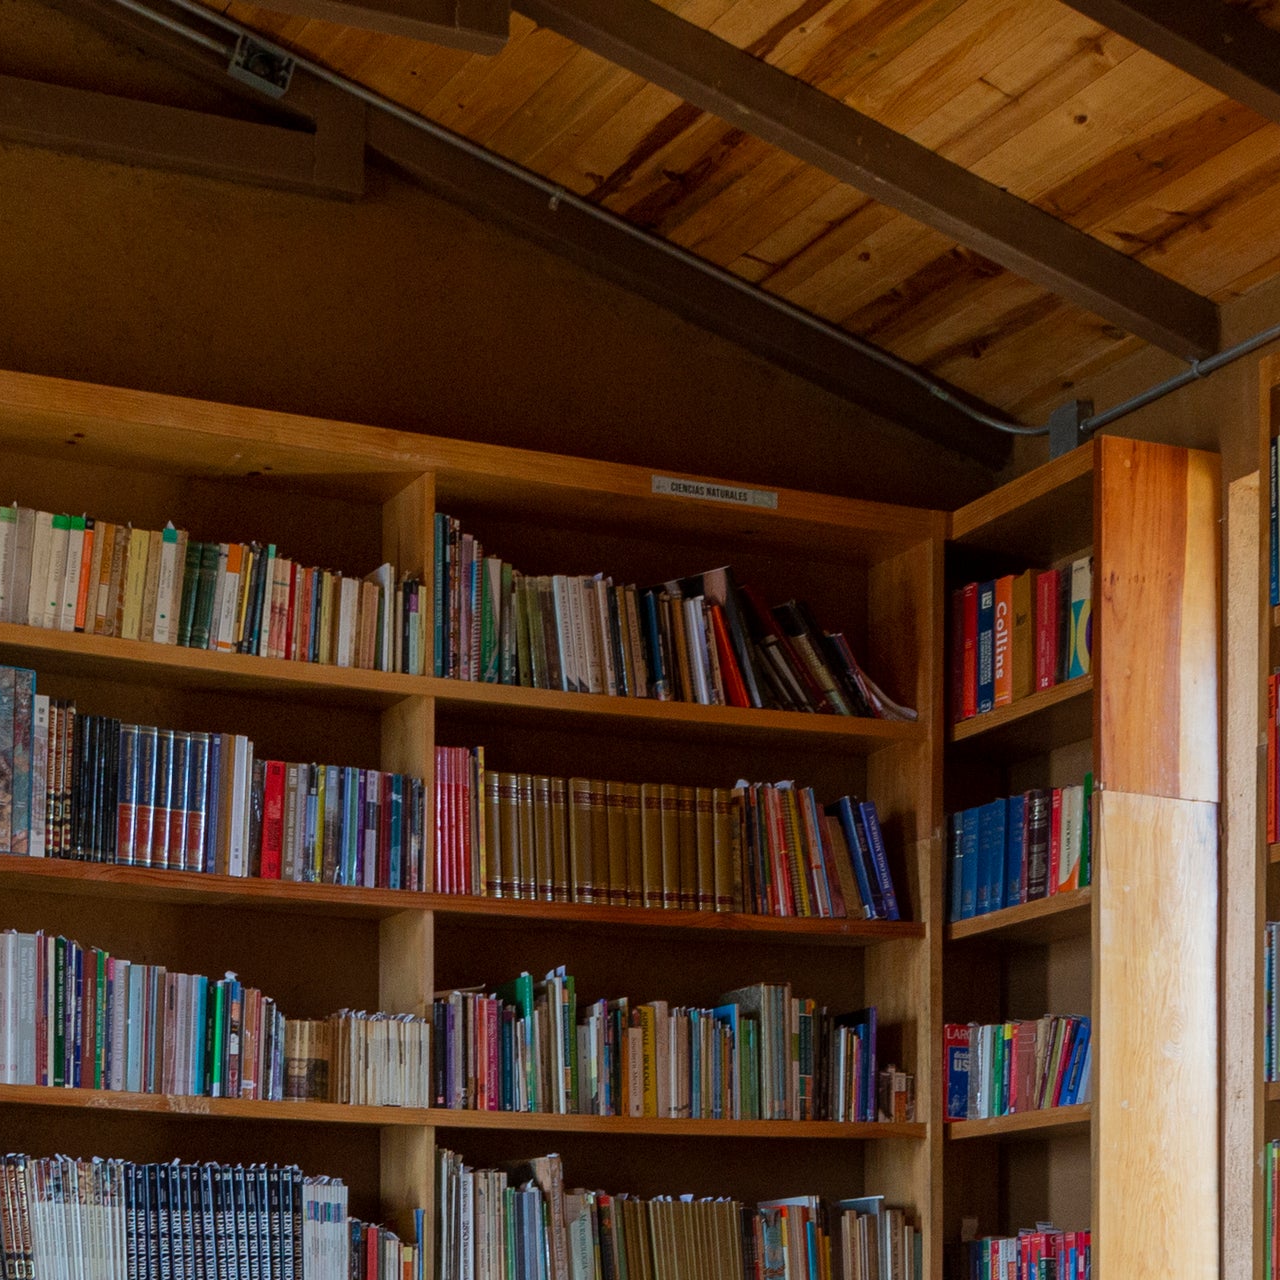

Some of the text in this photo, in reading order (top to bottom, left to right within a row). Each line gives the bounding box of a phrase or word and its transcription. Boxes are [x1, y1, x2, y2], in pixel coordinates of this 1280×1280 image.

[670, 482, 704, 496] CIENCIAS
[706, 487, 748, 502] NATURALES
[994, 601, 1007, 679] Collins
[868, 814, 882, 852] MODERNA
[127, 1209, 135, 1236] ARTE
[161, 1209, 169, 1236] ARTE
[172, 1209, 181, 1236] ARTE
[193, 1209, 201, 1236] ARTE
[216, 1209, 224, 1236] ARTE
[248, 1209, 257, 1236] ARTE
[271, 1209, 279, 1236] ARTE
[138, 1238, 146, 1256] DEL
[162, 1238, 170, 1256] DEL
[174, 1238, 182, 1256] DEL
[195, 1238, 203, 1256] DEL
[251, 1238, 259, 1256] DEL
